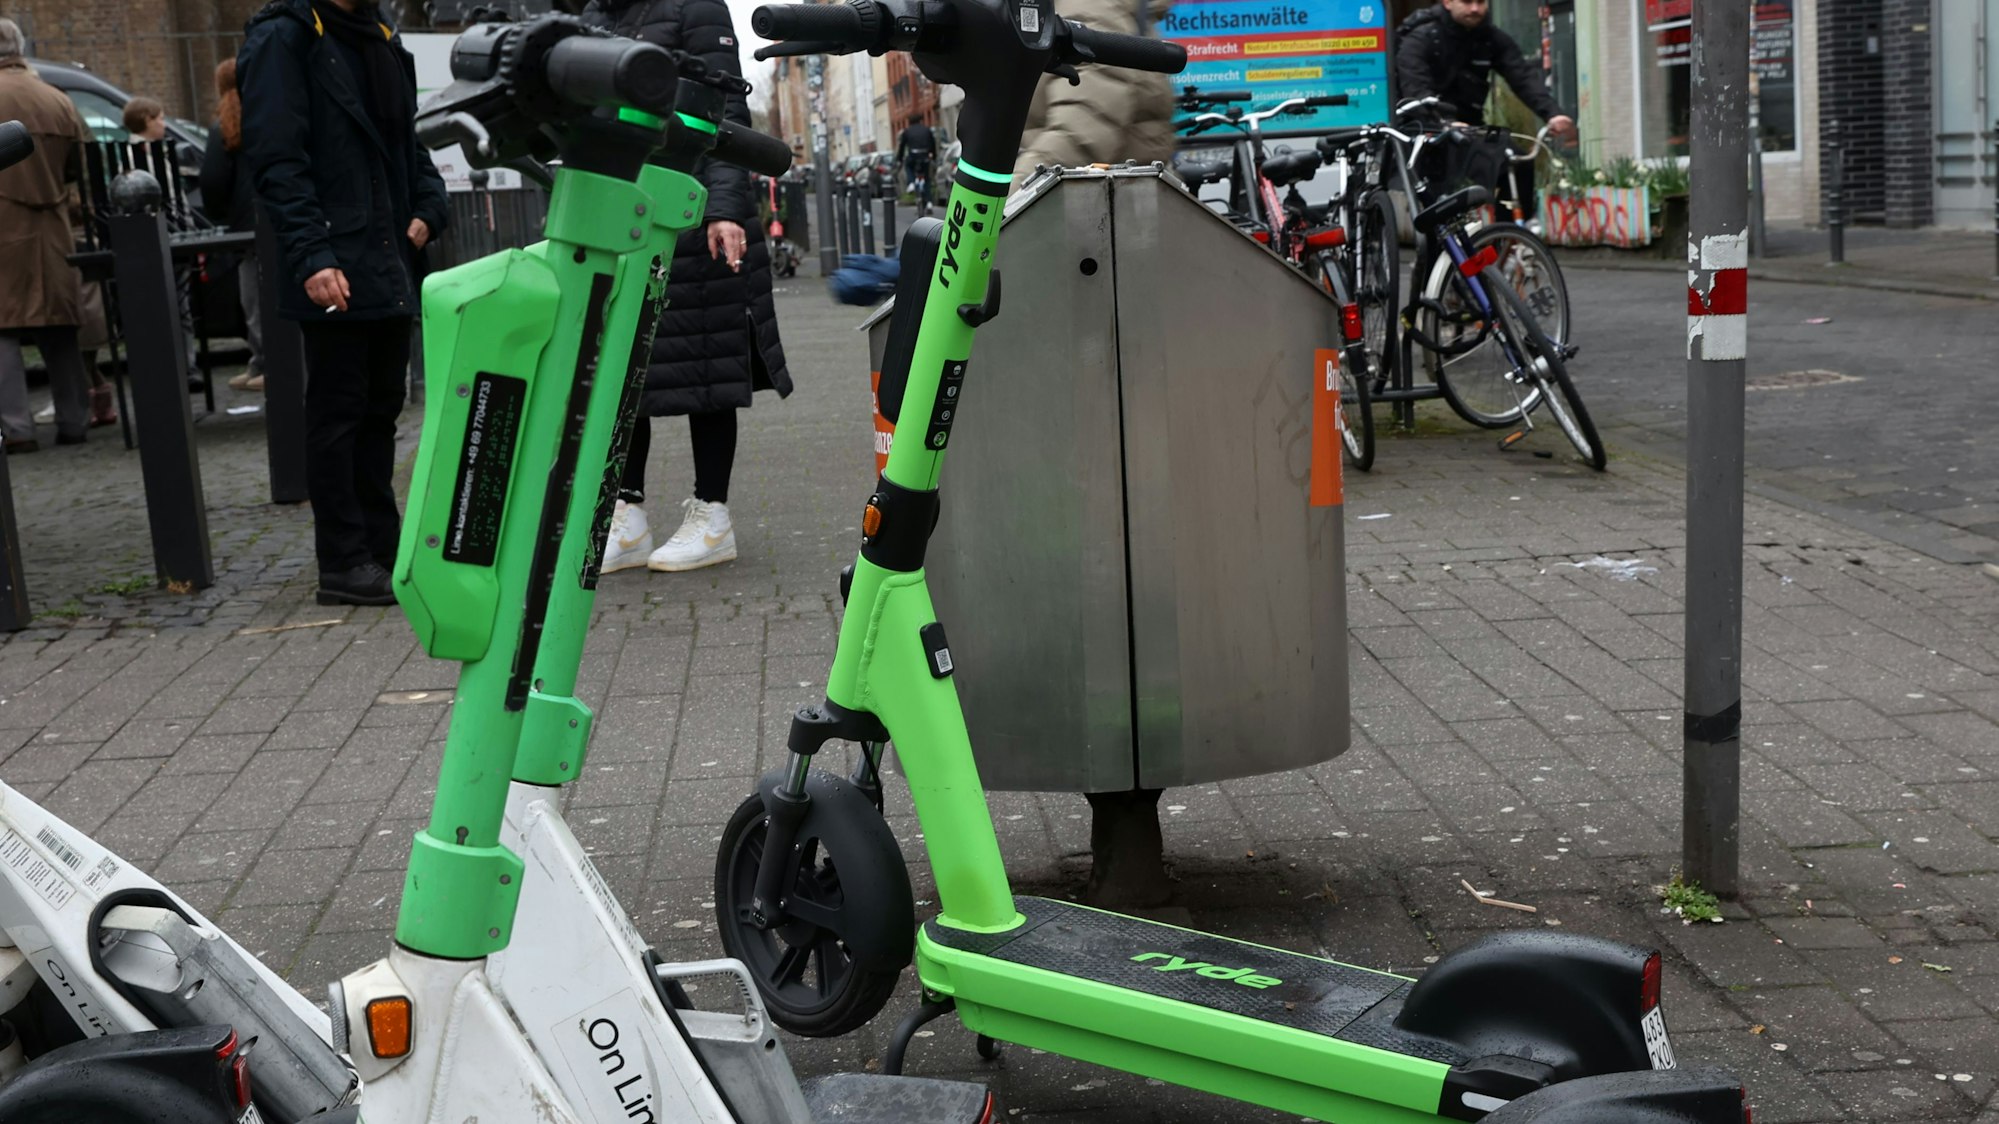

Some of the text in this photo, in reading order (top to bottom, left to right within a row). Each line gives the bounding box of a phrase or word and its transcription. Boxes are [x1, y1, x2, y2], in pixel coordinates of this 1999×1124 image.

[1165, 6, 1309, 31] Rechtsanwälte
[1186, 43, 1238, 56] Strafrecht
[1168, 70, 1240, 84] nsolvenzrecht
[939, 200, 967, 289] ryde
[471, 430, 482, 444] 69
[468, 445, 480, 465] +49
[450, 530, 464, 554] Lime
[47, 959, 76, 997] On
[1130, 952, 1283, 990] ryde
[1645, 1012, 1663, 1046] 483
[588, 1018, 625, 1075] On
